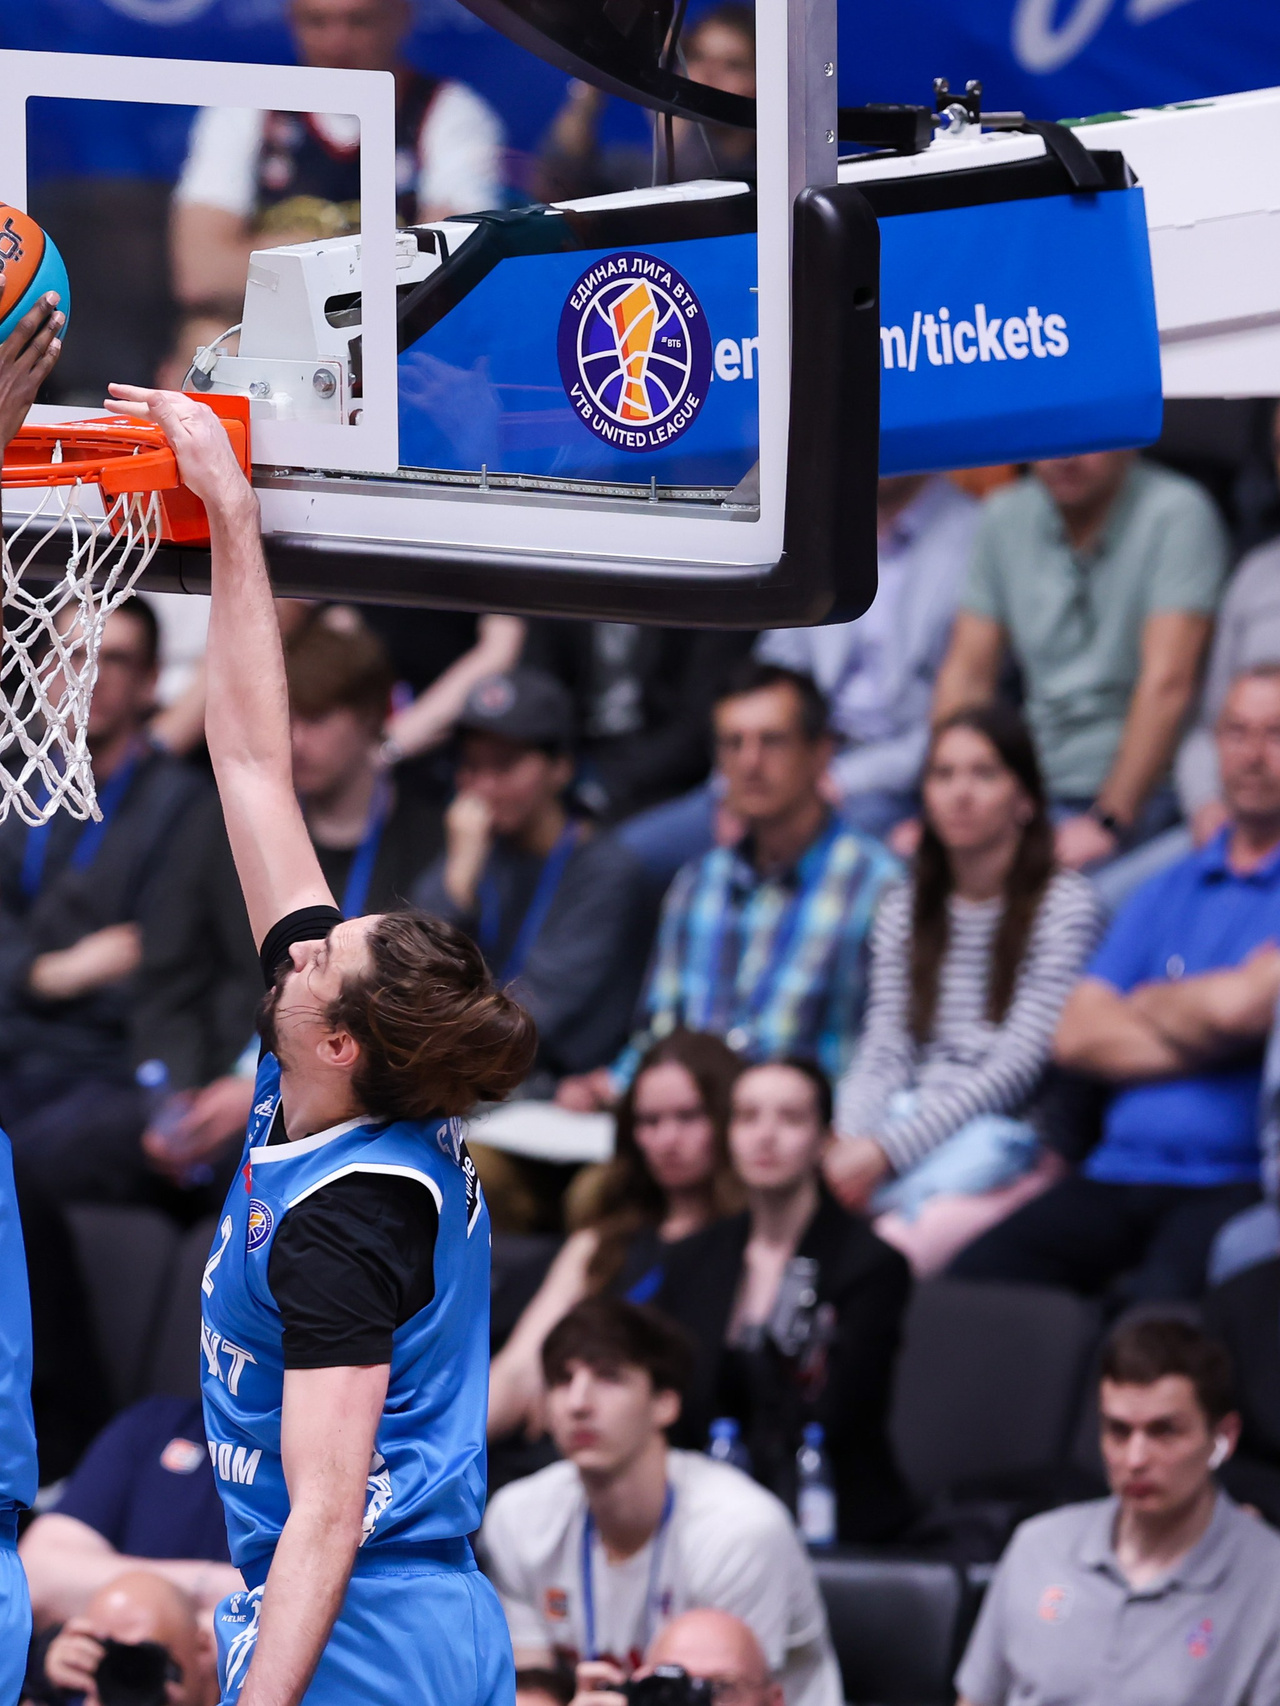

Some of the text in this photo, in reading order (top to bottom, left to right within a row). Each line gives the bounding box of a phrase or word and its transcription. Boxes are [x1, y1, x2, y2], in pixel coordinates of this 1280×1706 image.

[570, 258, 698, 319] ЕДИНАЯ ЛИГА ВТБ
[570, 382, 700, 447] VTB UNITED LEAGUE
[221, 1614, 247, 1623] KELME
